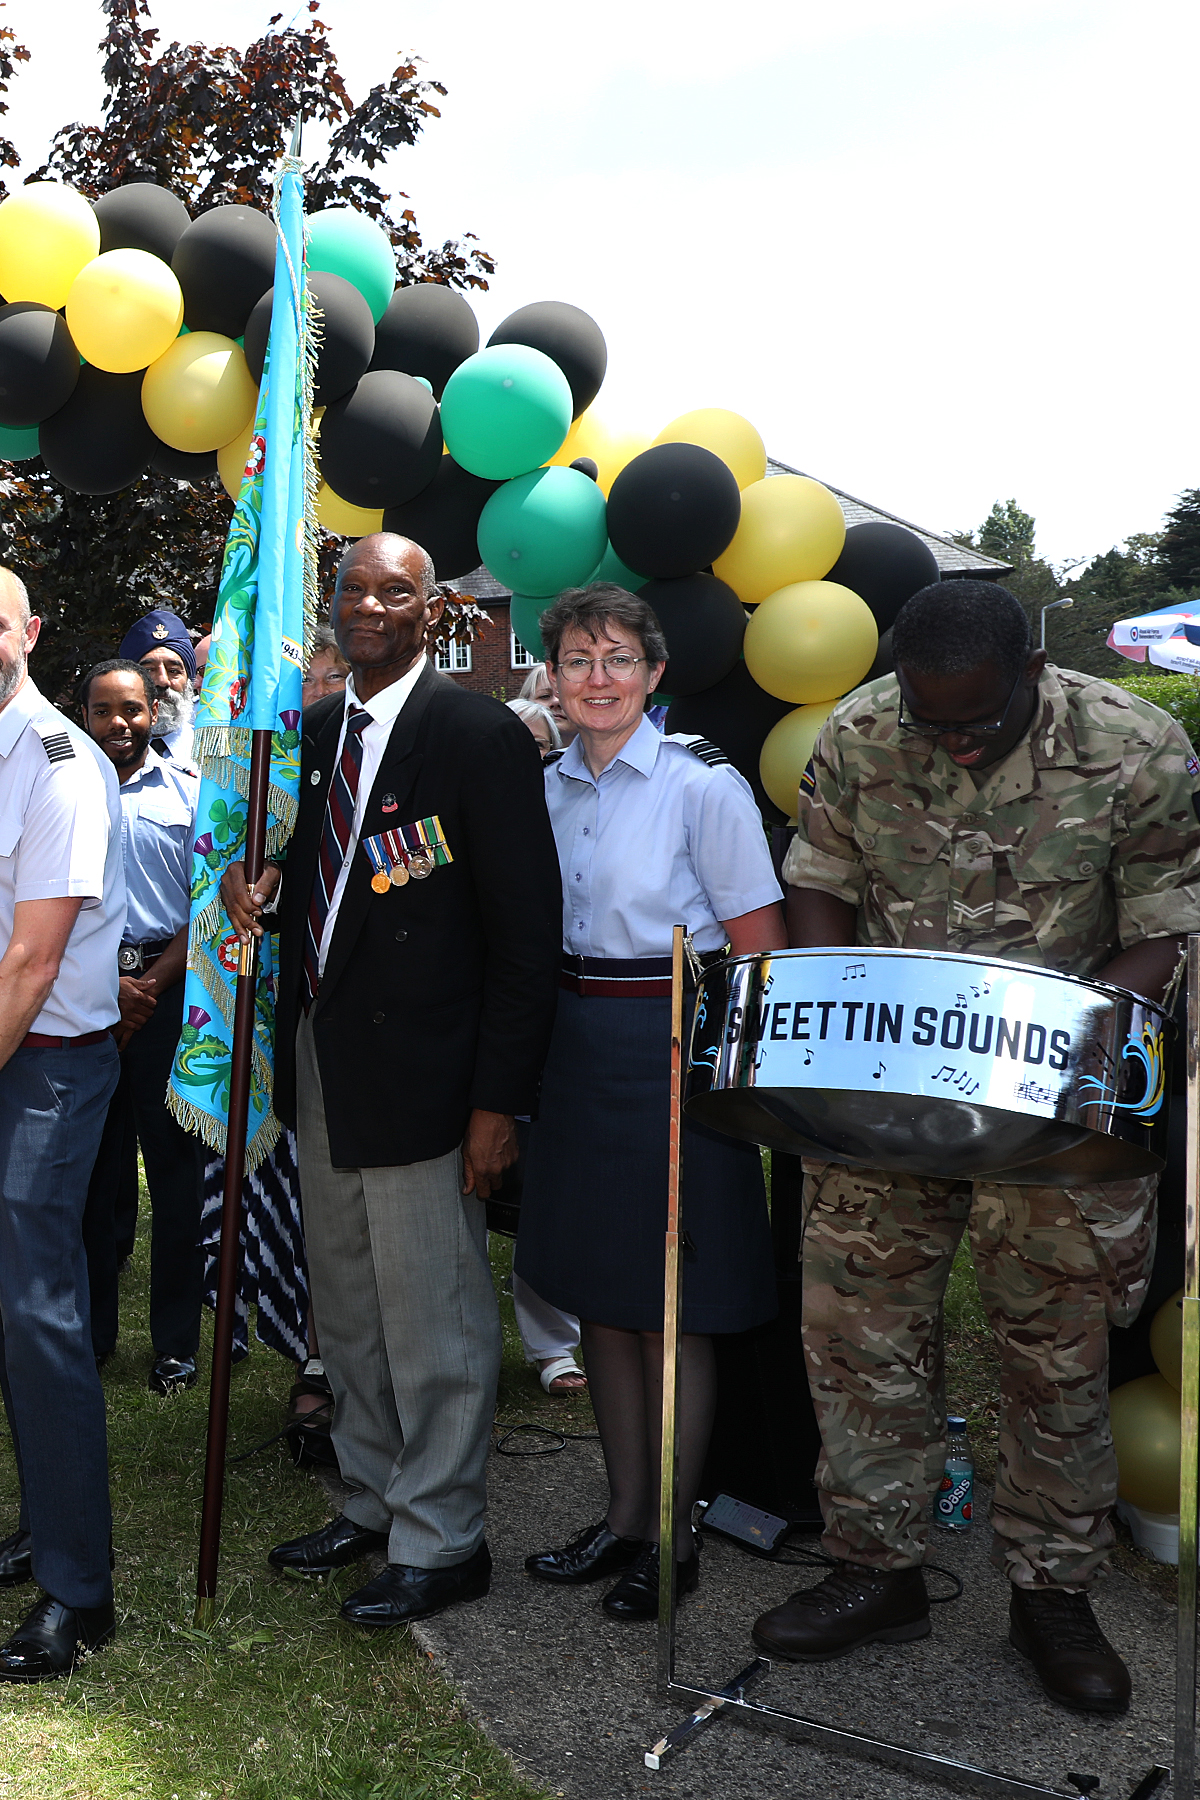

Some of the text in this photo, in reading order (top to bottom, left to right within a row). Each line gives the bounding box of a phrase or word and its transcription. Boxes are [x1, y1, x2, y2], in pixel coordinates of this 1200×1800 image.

[727, 1001, 1071, 1071] SWEET TIN SOUNDS
[938, 1479, 971, 1515] Oasis
